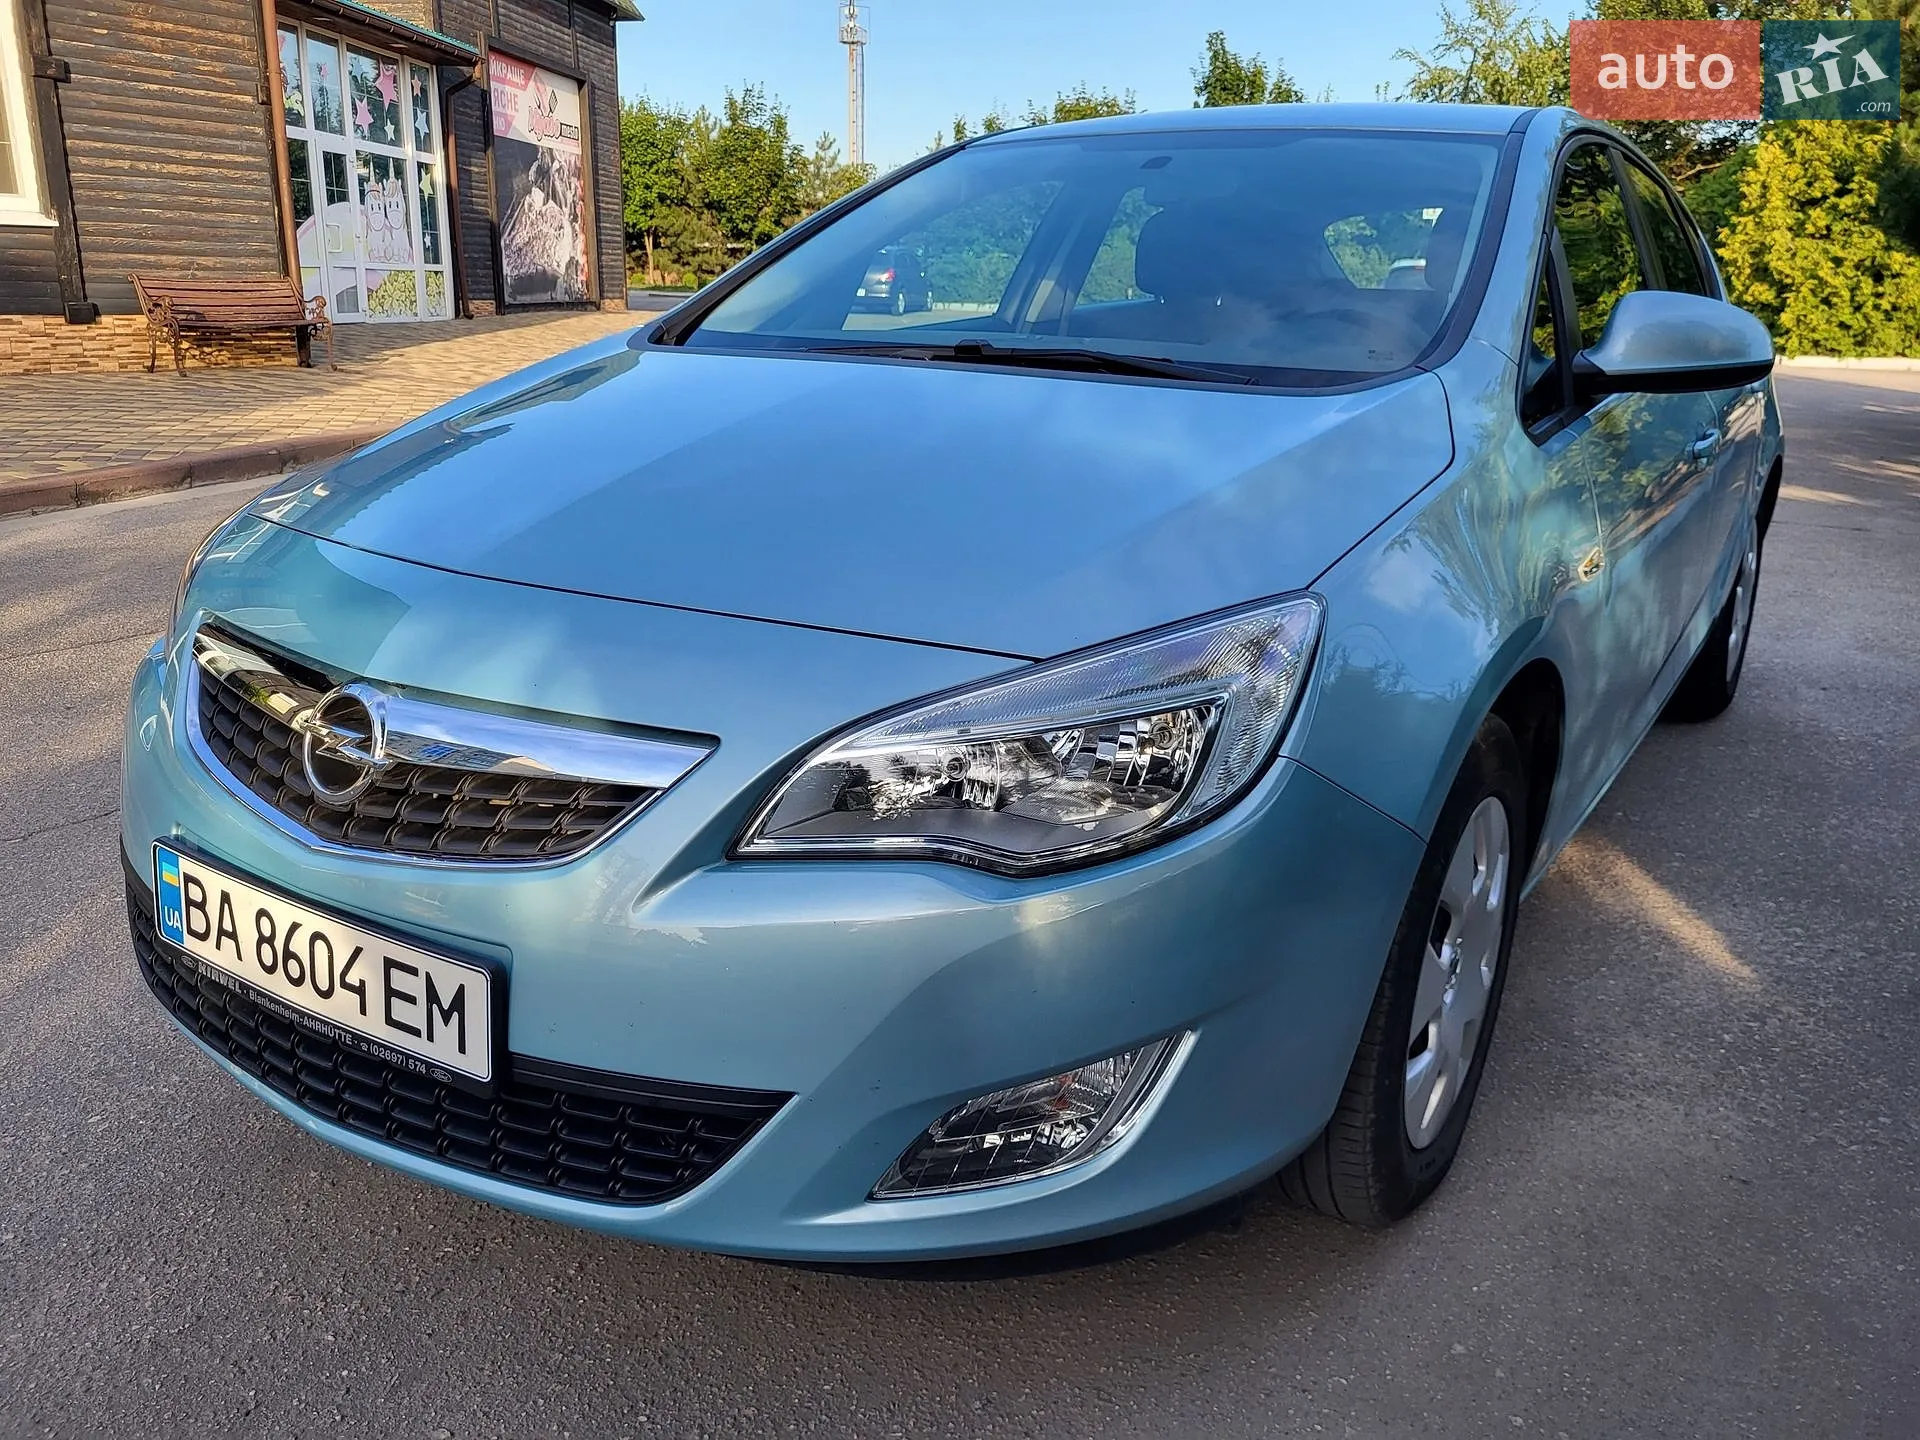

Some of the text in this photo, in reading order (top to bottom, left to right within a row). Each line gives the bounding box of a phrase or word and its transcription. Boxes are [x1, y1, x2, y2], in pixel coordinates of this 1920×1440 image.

[165, 905, 183, 932] UA
[182, 871, 467, 1056] BA 8604 EM
[370, 1044, 406, 1067] (02697)
[408, 1060, 426, 1074] 574
